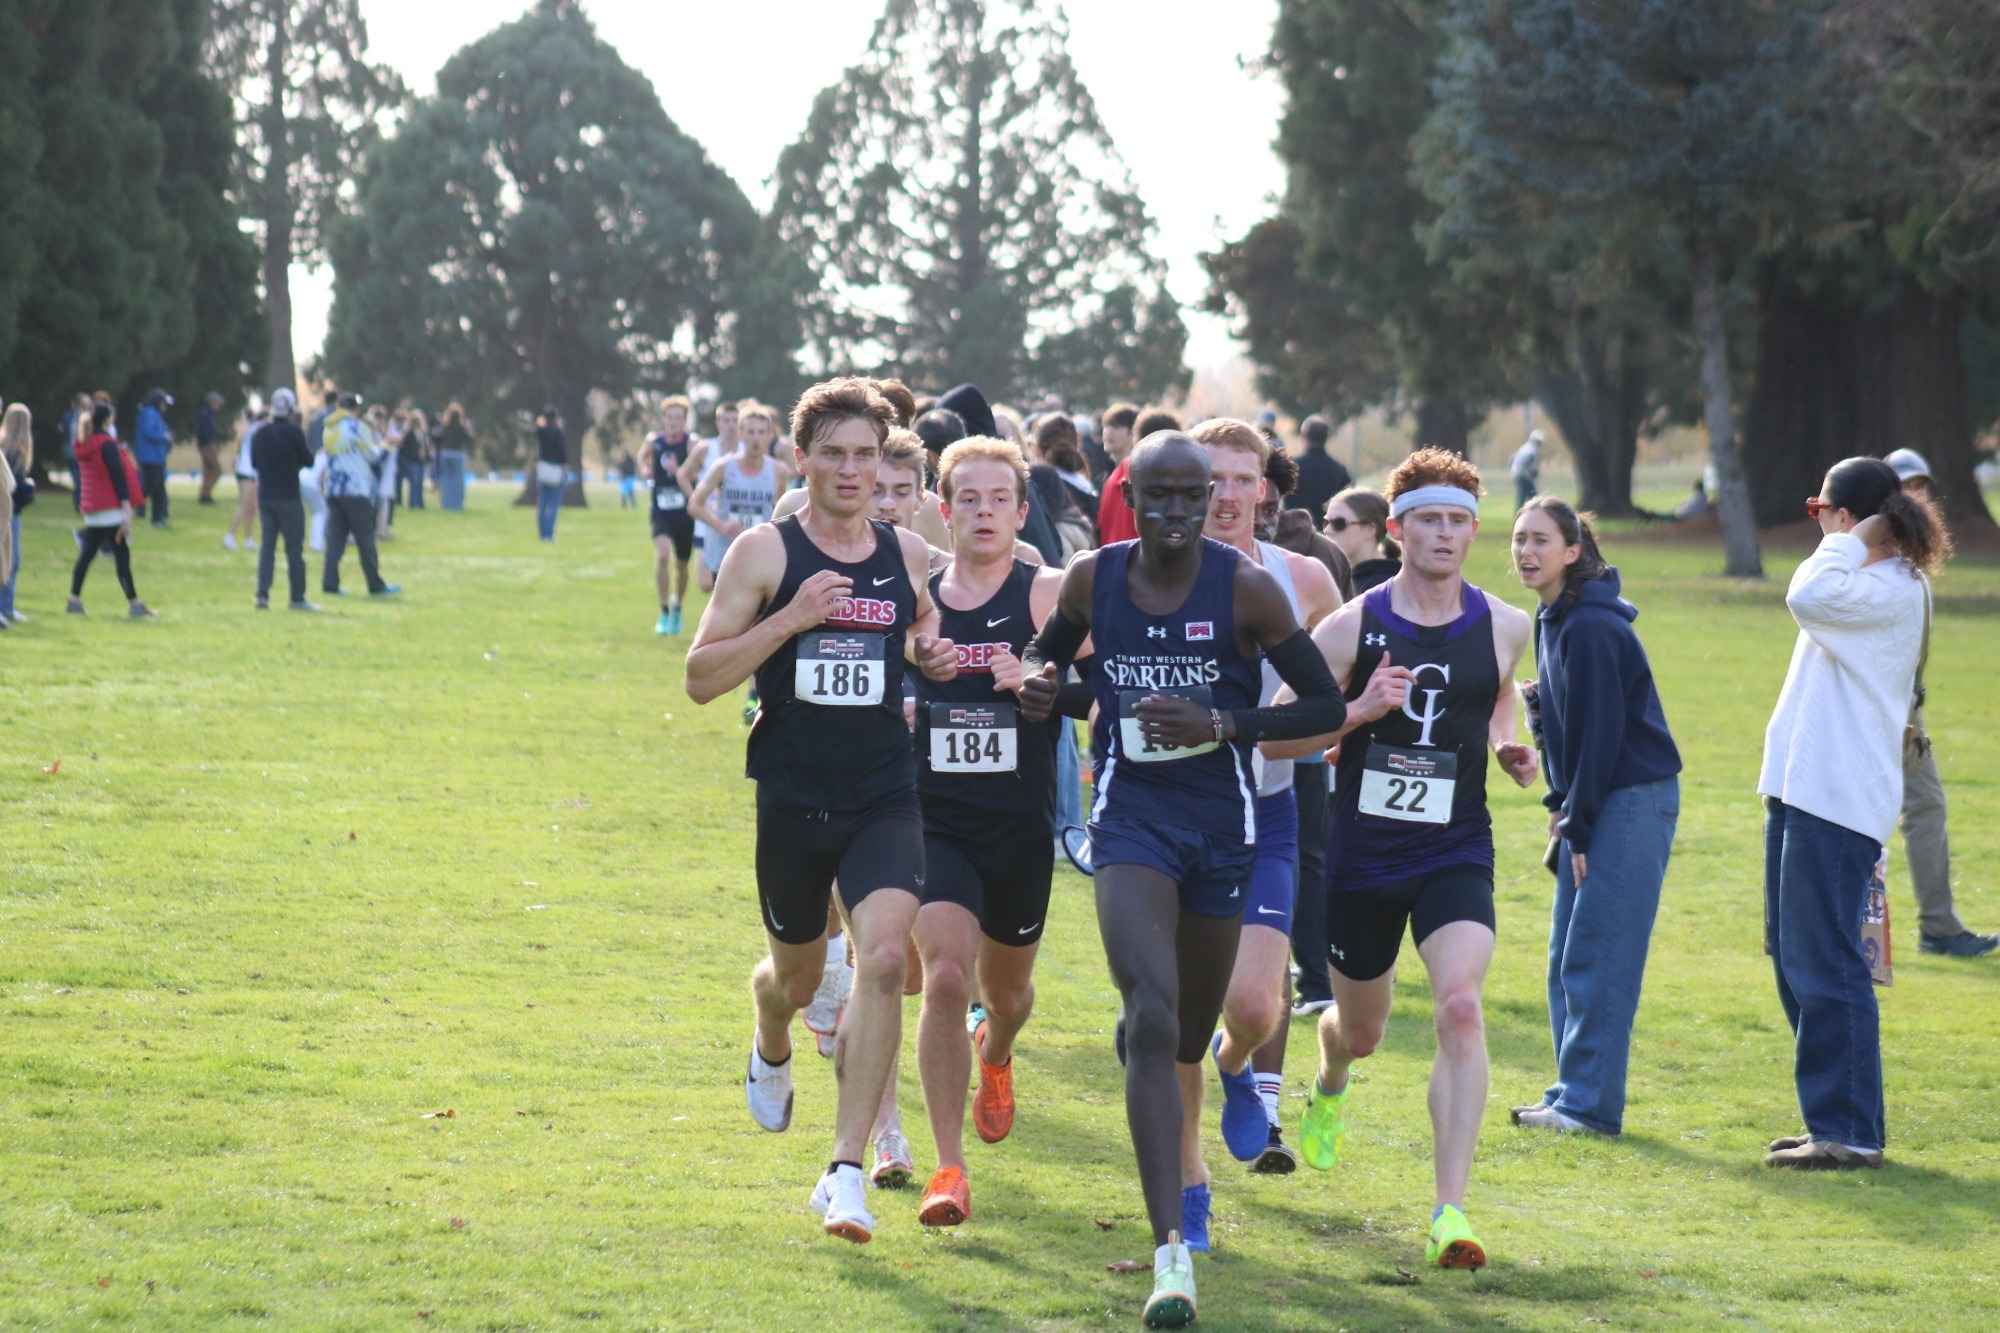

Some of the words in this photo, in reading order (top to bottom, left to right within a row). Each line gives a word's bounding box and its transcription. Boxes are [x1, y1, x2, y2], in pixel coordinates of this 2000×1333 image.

[824, 596, 896, 625] IDERS
[1103, 659, 1221, 690] SPARTANS
[1116, 654, 1151, 663] TRINITY
[1155, 656, 1202, 664] WESTERN
[813, 663, 869, 697] 186
[946, 732, 1002, 763] 184
[1385, 778, 1428, 813] 22
